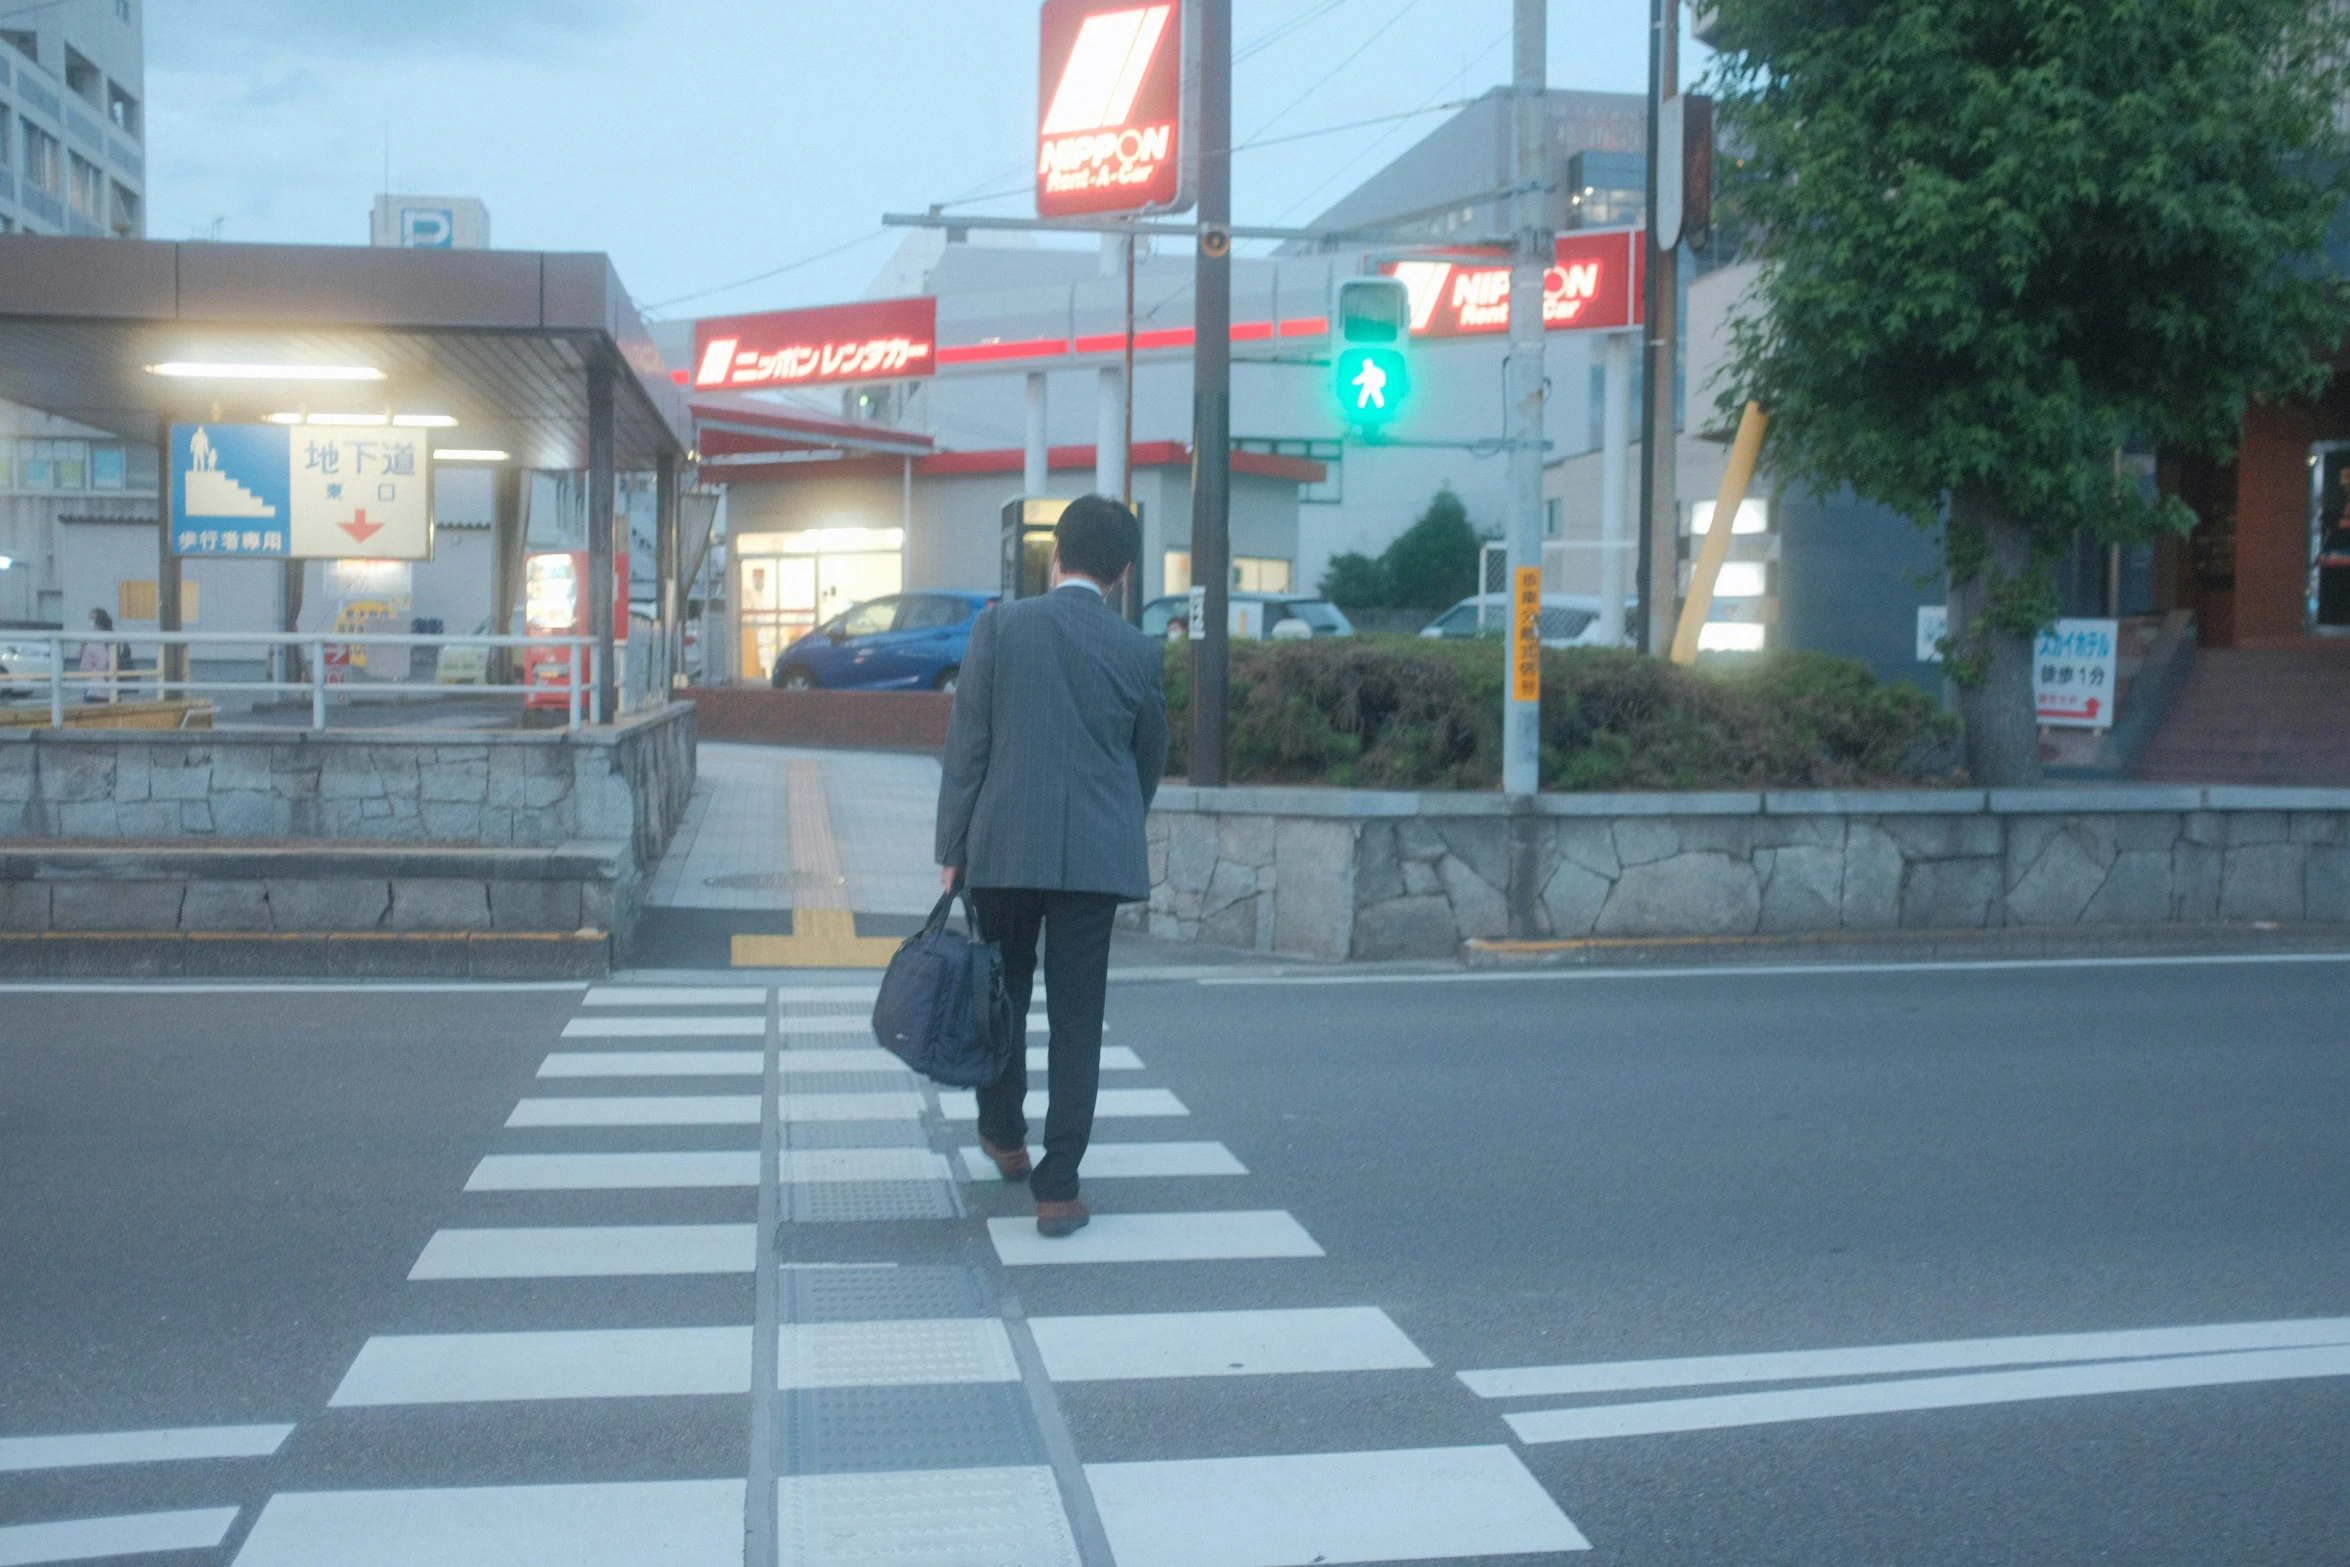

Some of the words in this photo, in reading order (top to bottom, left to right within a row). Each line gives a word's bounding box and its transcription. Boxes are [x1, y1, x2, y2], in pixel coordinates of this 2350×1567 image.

[1039, 125, 1169, 174] NIPPON
[403, 210, 450, 248] P
[1451, 263, 1599, 307] NIPON
[304, 440, 416, 476] 地下道
[179, 530, 282, 551] 歩行者専用
